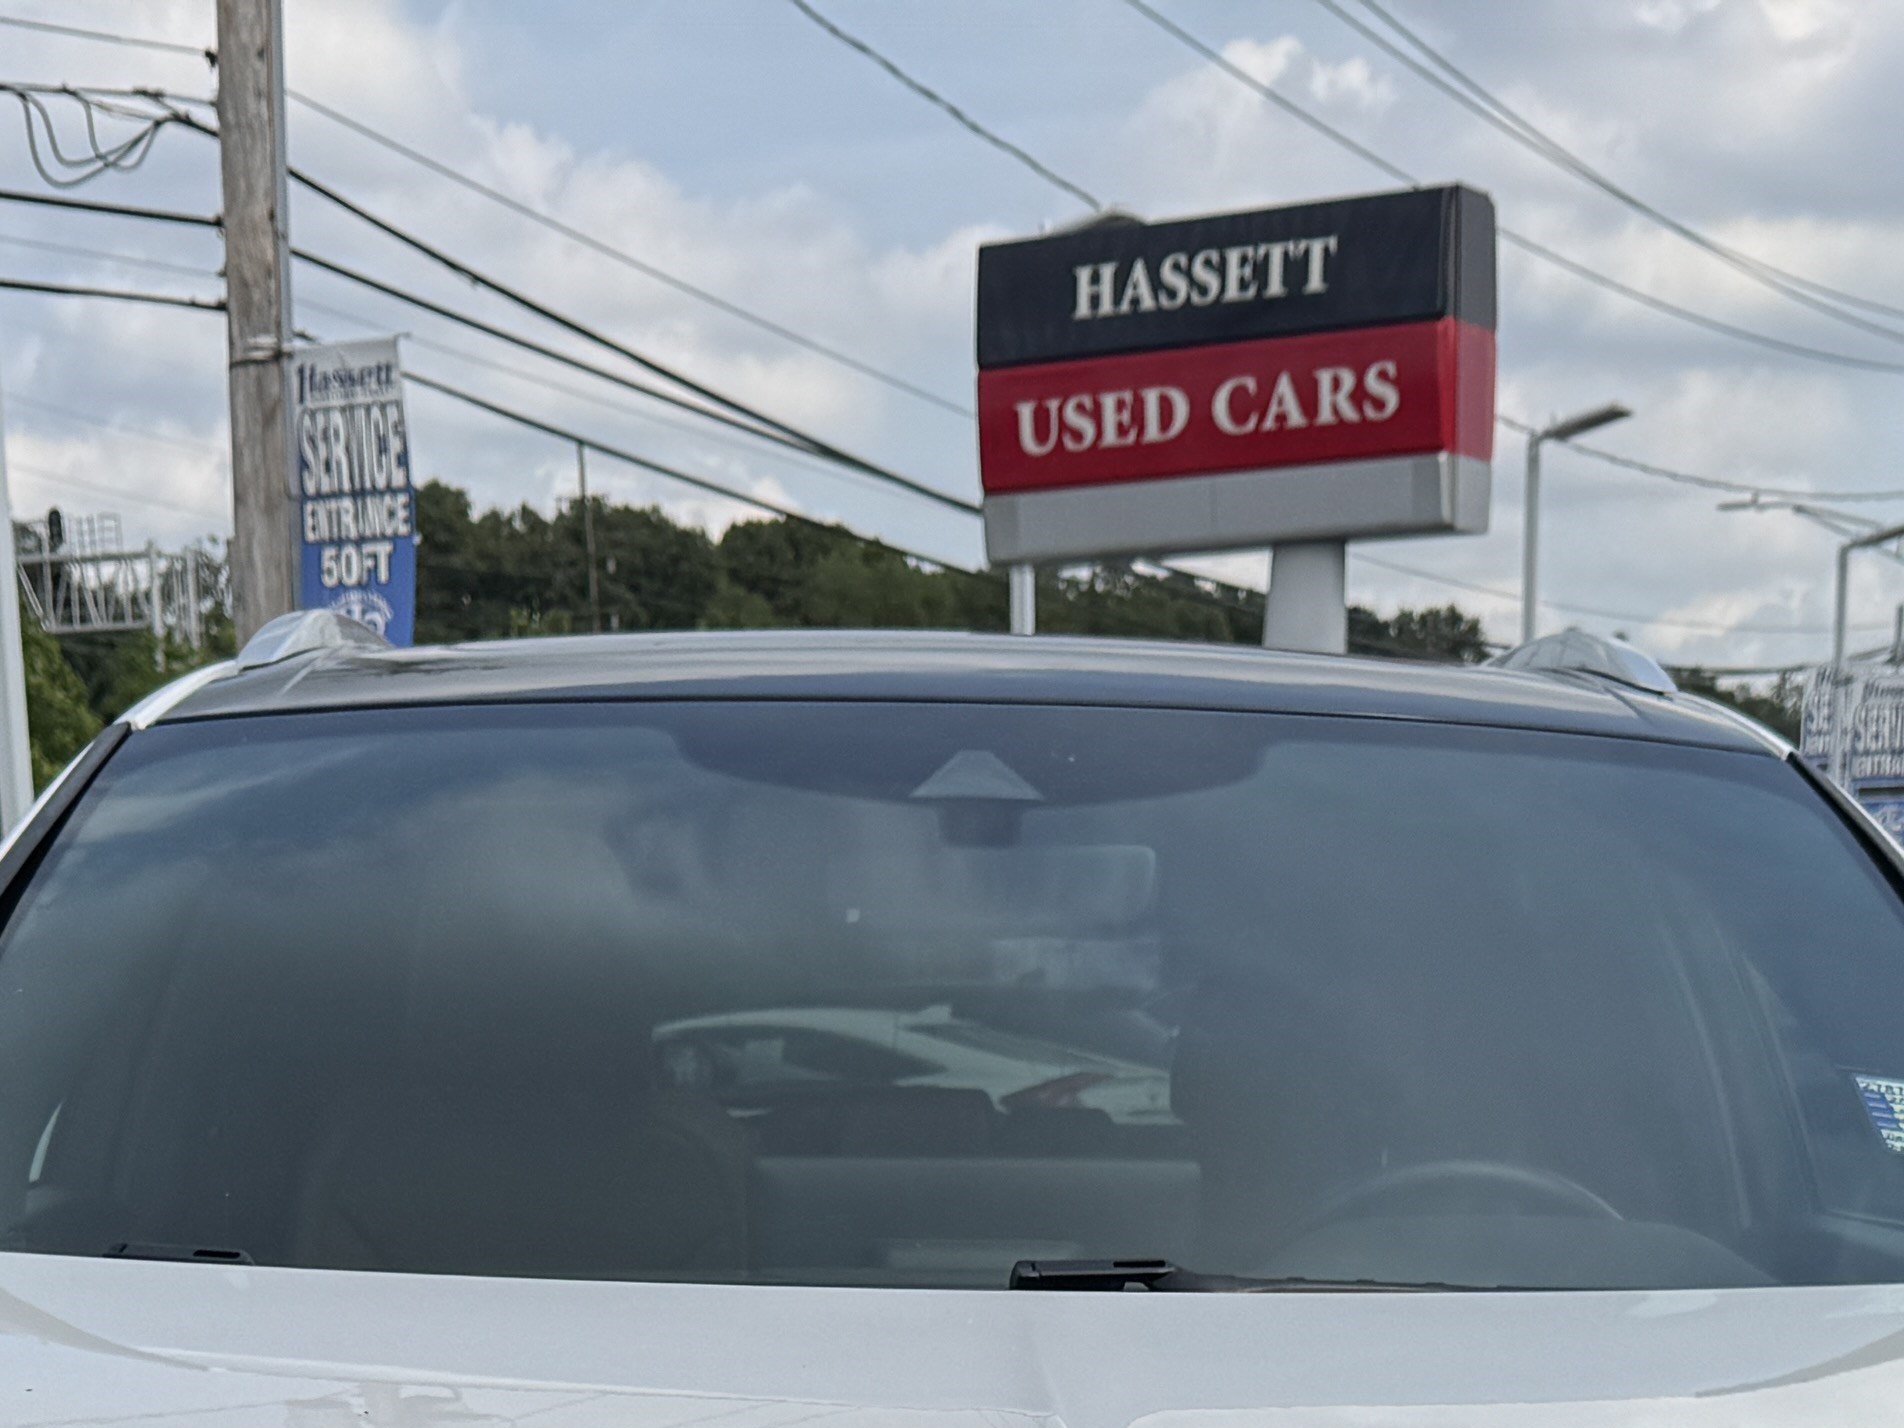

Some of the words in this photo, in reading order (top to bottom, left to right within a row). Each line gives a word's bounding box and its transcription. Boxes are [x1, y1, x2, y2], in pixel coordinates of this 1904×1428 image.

[1072, 235, 1339, 320] HASSETT
[302, 404, 408, 497] SERVICE
[1015, 385, 1190, 458] USED
[1211, 360, 1400, 436] CARS
[304, 493, 411, 543] ENTRANCE
